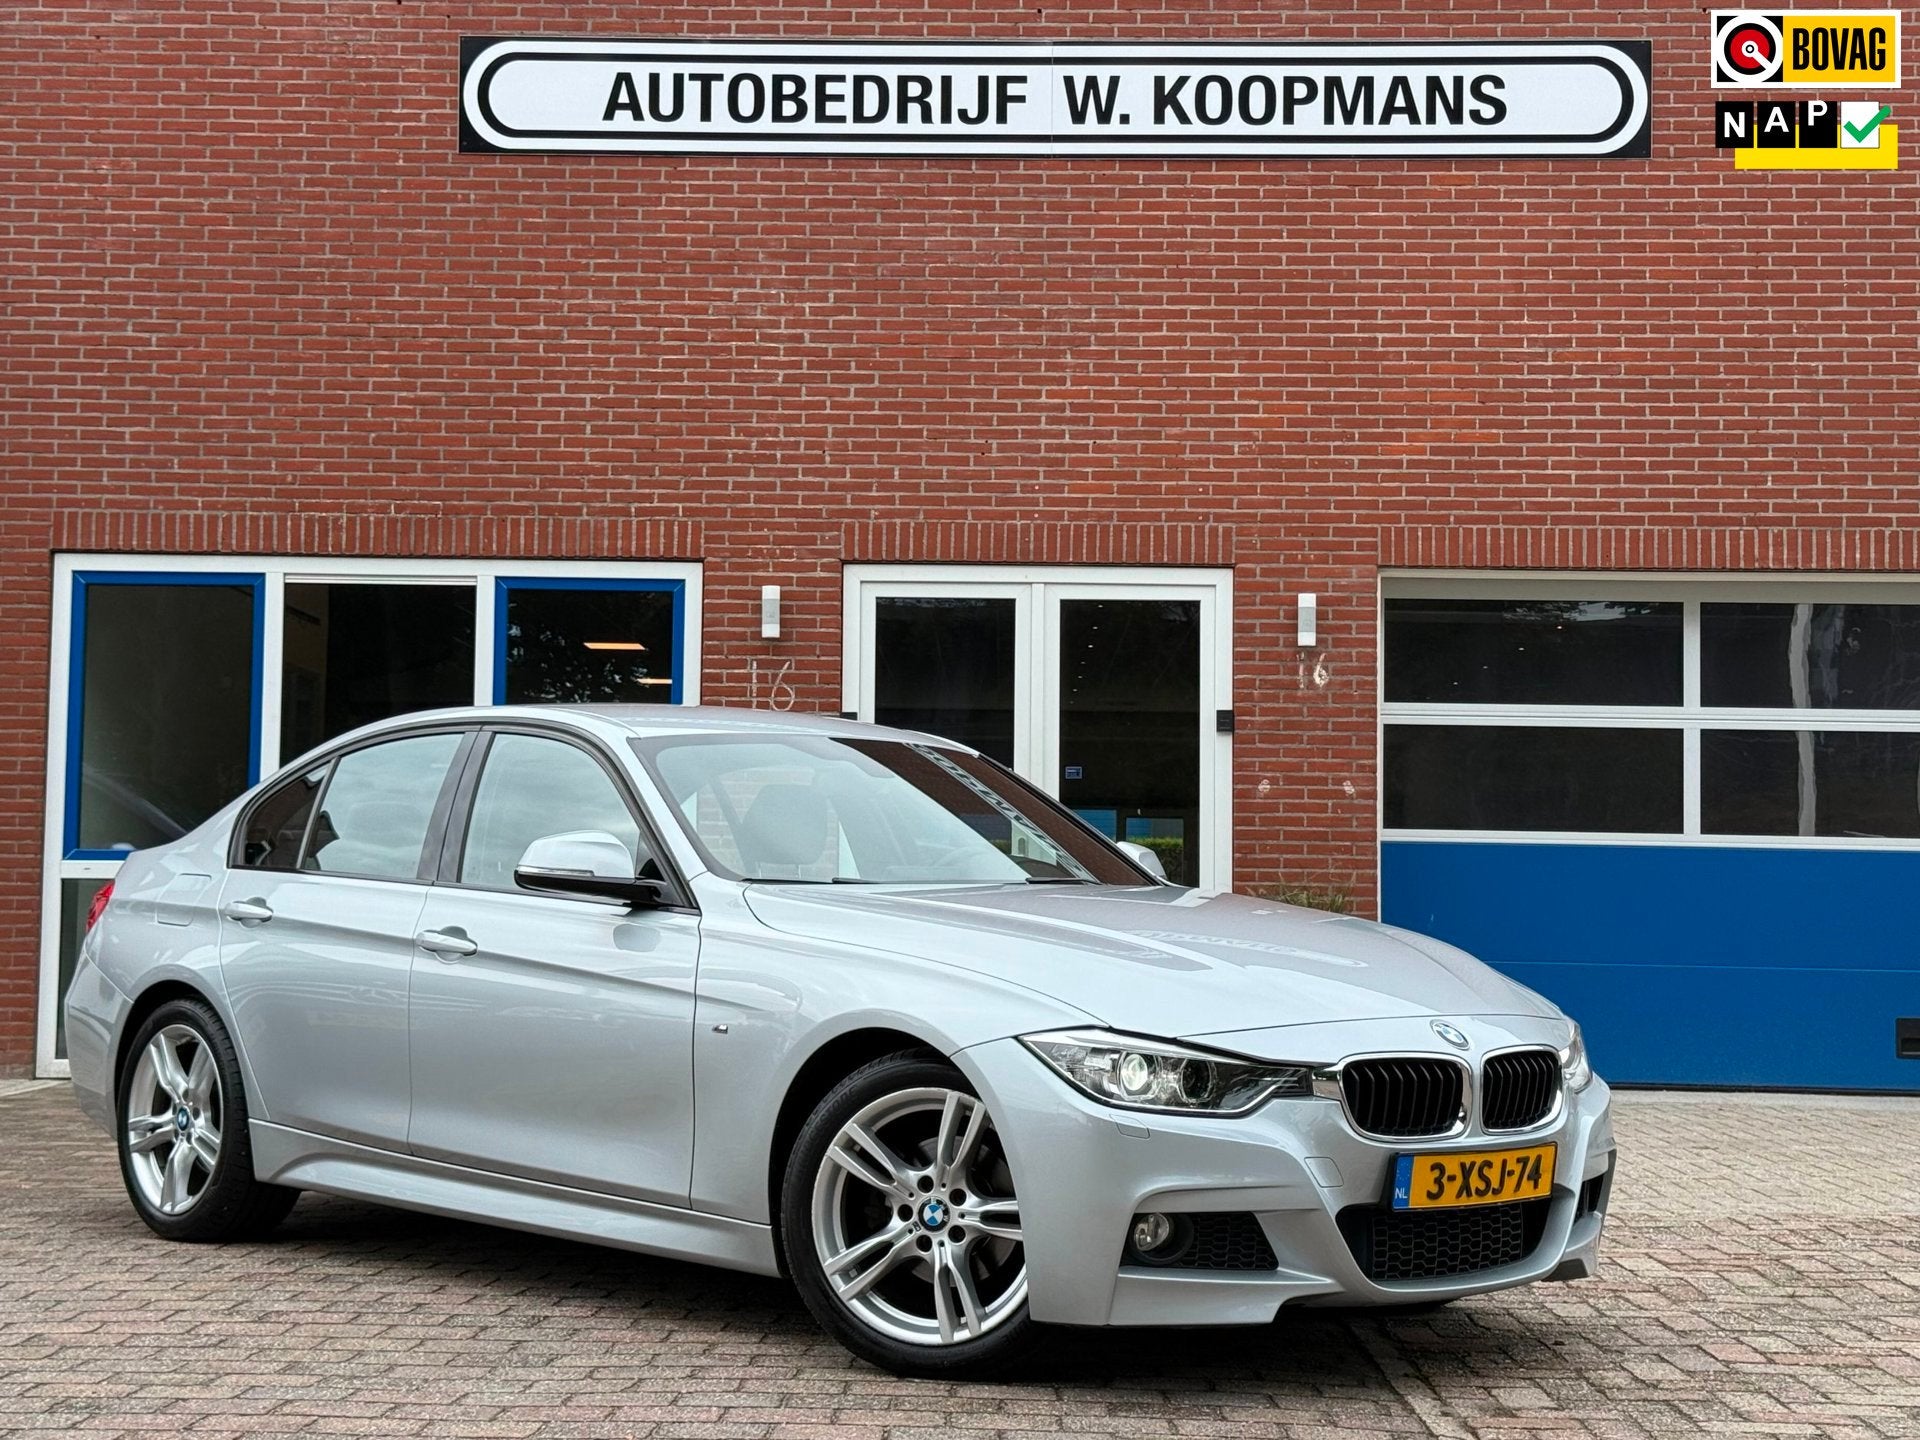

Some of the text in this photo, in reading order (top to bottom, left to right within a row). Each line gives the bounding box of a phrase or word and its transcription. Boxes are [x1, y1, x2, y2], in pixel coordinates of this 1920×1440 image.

[602, 71, 1507, 126] AUTOBEDRIJF W. KOOPMANS
[751, 660, 795, 711] 16
[1394, 1153, 1543, 1200] NL 3-XSJ-74
